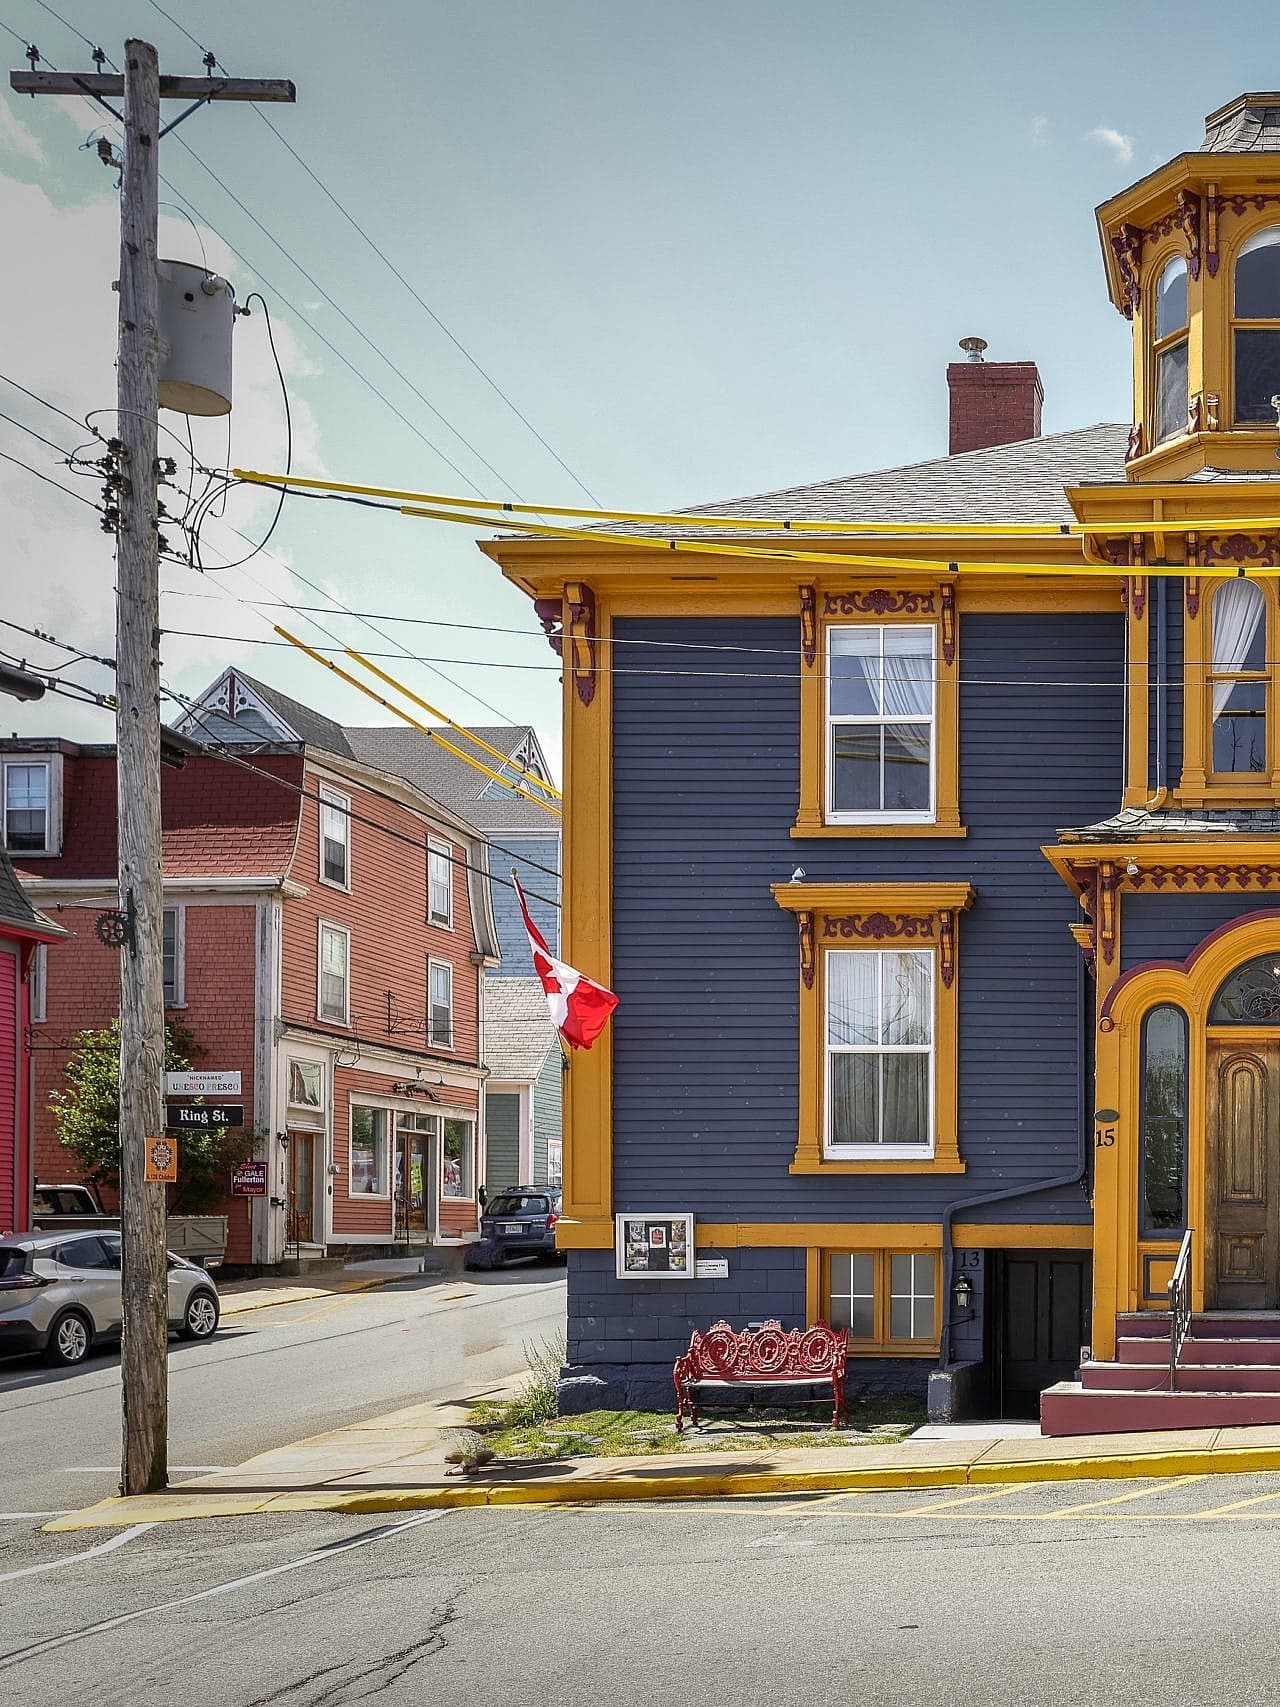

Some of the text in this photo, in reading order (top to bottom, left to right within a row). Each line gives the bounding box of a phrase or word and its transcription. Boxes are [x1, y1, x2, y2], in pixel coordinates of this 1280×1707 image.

[172, 1083, 239, 1091] UNESCO FRESCO
[179, 1109, 229, 1124] King St.
[1095, 1128, 1115, 1148] 15
[233, 1175, 265, 1183] Fullerton
[960, 1251, 980, 1268] 13
